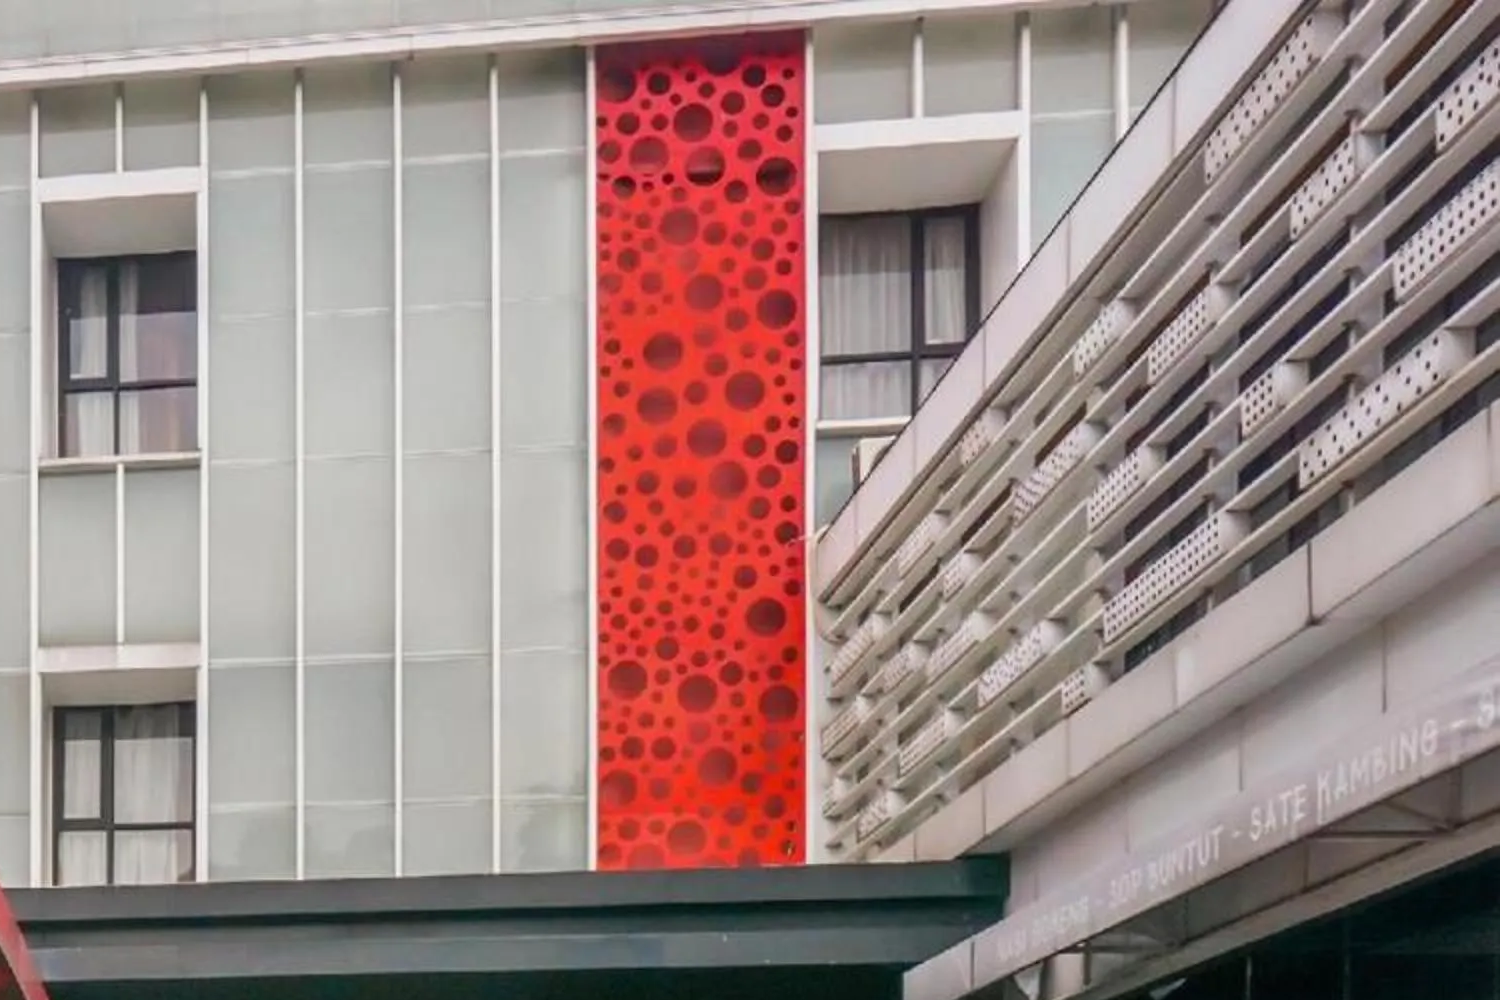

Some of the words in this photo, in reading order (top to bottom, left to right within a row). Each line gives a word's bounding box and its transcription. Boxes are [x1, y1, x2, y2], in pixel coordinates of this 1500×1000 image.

[1146, 824, 1225, 892] BUNTUT
[1250, 783, 1308, 842] SATE
[1316, 719, 1439, 807] KAMBING
